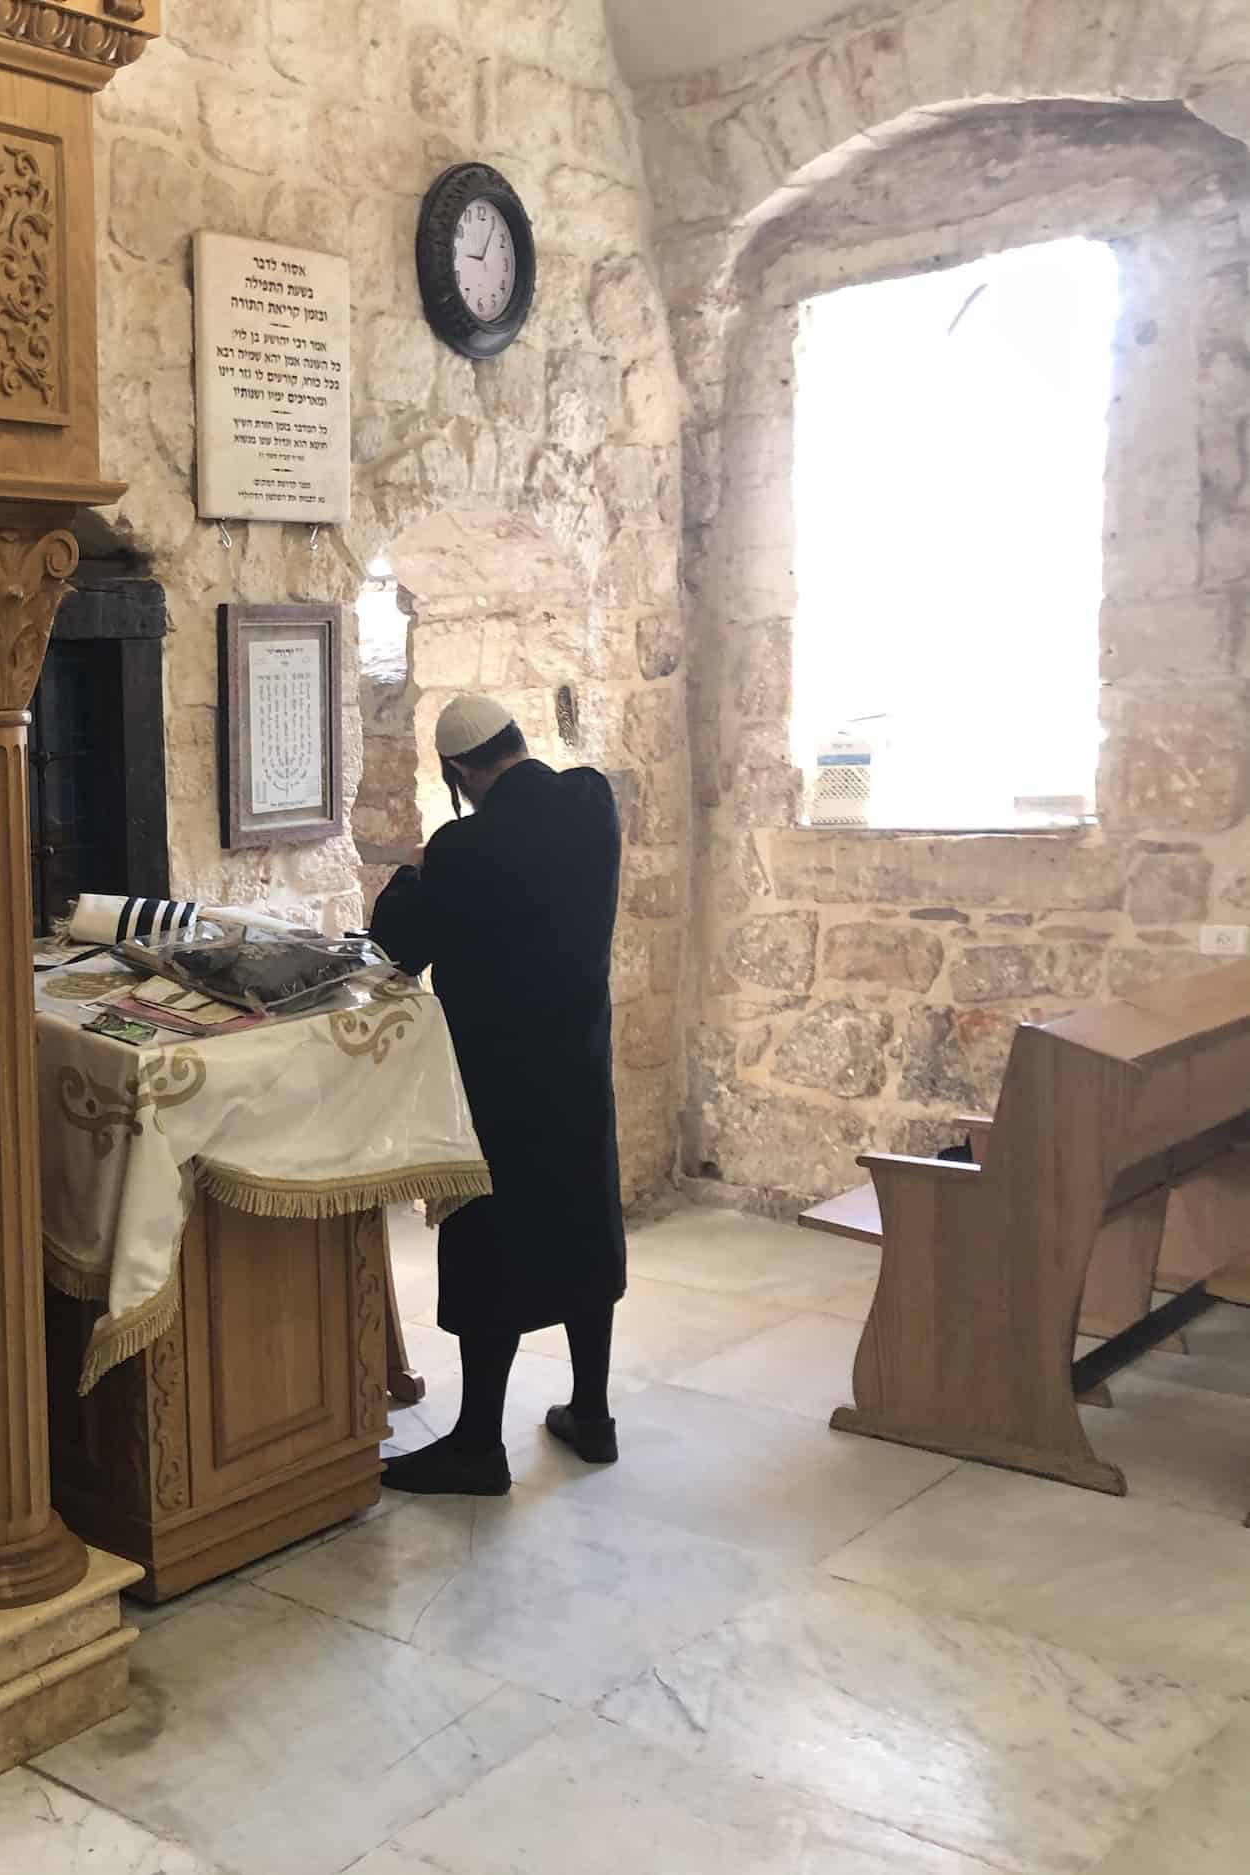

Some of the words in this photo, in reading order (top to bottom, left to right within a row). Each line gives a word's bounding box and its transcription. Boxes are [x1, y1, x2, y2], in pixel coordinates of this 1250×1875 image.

[253, 256, 277, 271] לדבר
[281, 262, 306, 277] אסור
[245, 276, 283, 294] התפילה
[288, 285, 314, 299] בשעת
[231, 296, 264, 312] התורה
[268, 303, 300, 319] קריאת
[304, 308, 327, 322] ובזמן
[251, 331, 260, 344] בן
[217, 346, 234, 357] רבא
[331, 359, 341, 372] כל
[255, 369, 263, 380] לו
[324, 378, 339, 390] בכל
